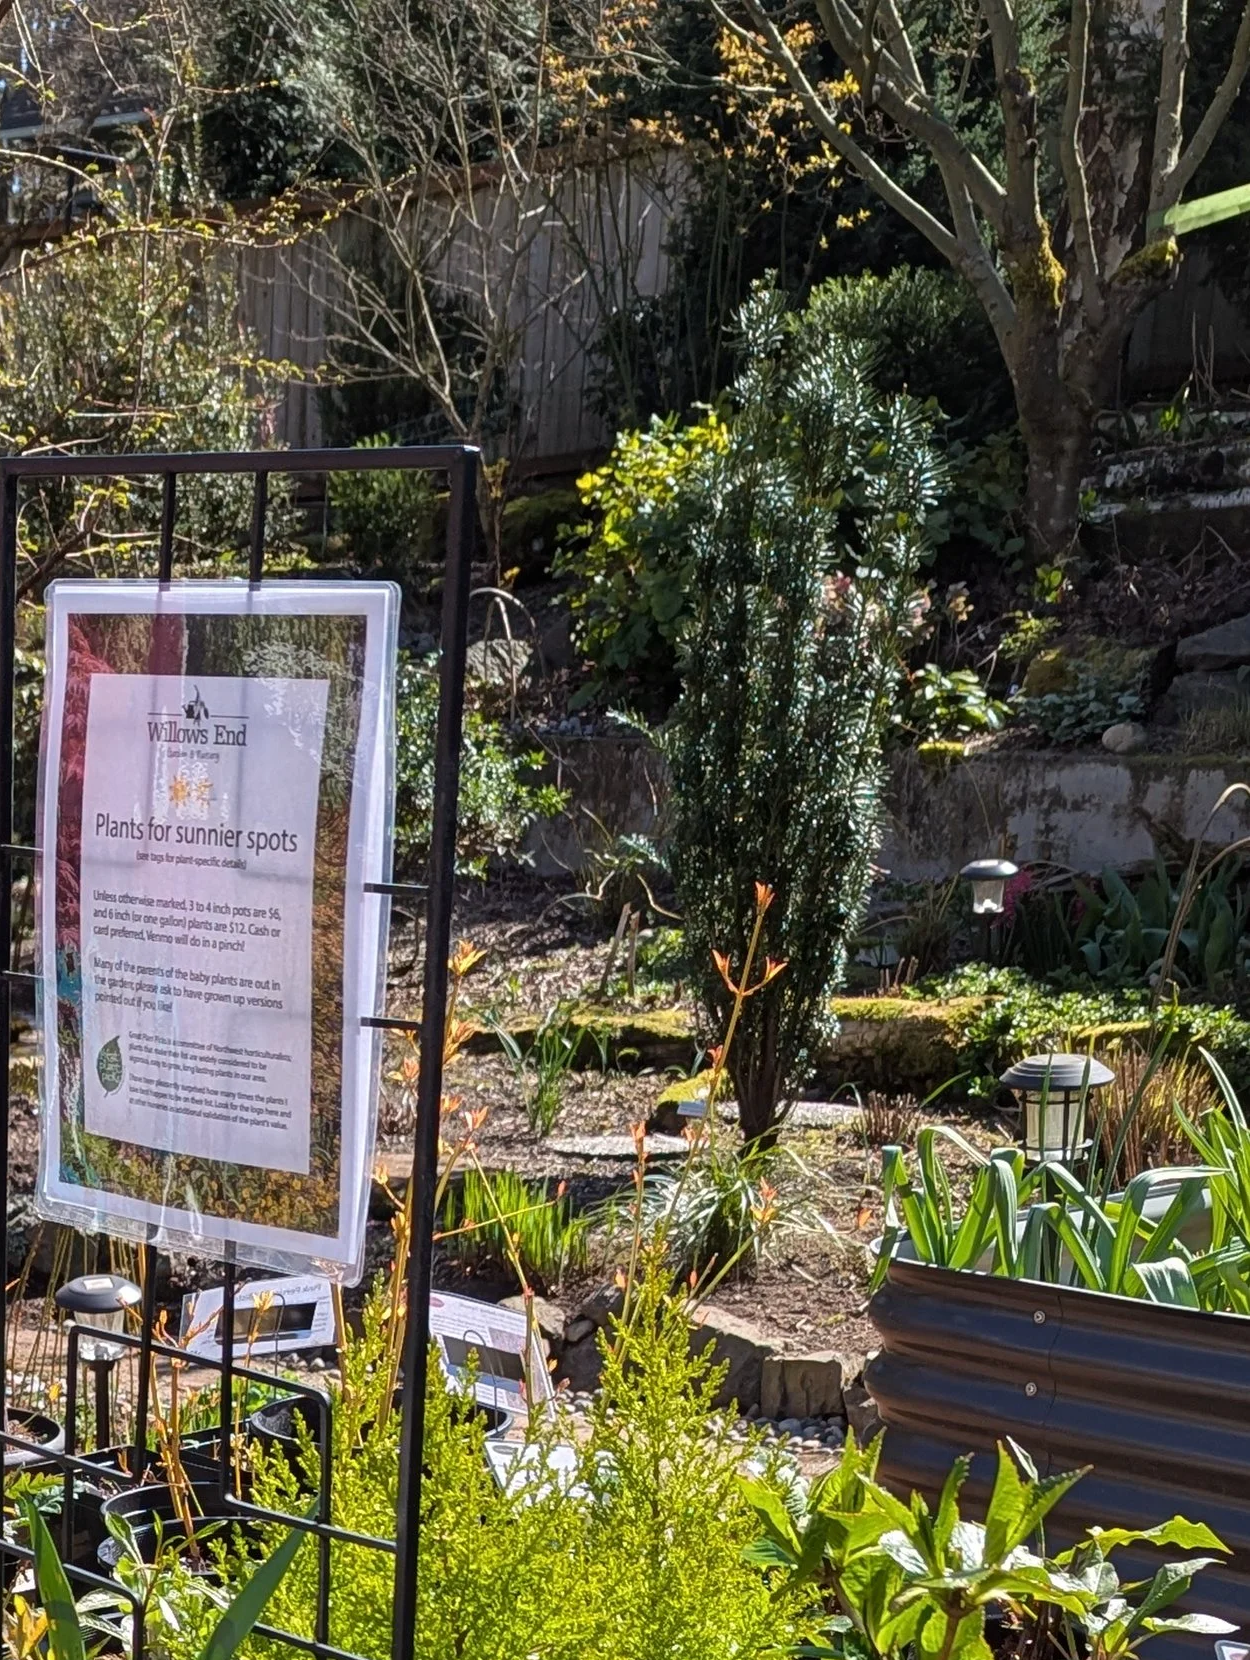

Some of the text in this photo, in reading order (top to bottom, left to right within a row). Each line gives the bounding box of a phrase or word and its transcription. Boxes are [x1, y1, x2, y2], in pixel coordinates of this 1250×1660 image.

[147, 721, 247, 747] Willows End
[96, 813, 297, 856] Plants for sunnier spots
[93, 890, 282, 921] Unless otherwise marked, 3 to 4 inch pots are $6,
[93, 908, 107, 919] and
[108, 908, 114, 920] 6
[114, 909, 131, 921] inch
[131, 910, 143, 923] (or
[143, 915, 158, 925] one
[159, 915, 187, 929] gallon)
[188, 917, 213, 931] plants
[213, 922, 228, 933] are
[248, 923, 270, 936] Cash
[271, 928, 281, 938] or
[93, 925, 245, 952] card preferred, Venmo will do in a pinch!
[93, 956, 281, 991] Many of the parents of the baby plants are out in
[94, 974, 106, 985] the
[135, 980, 158, 994] please
[159, 984, 172, 996] ask
[173, 986, 182, 997] to
[183, 986, 203, 1000] have
[203, 992, 232, 1003] grown
[233, 995, 245, 1007] up
[246, 996, 283, 1010] versions
[94, 992, 173, 1013] pointed out if you like!
